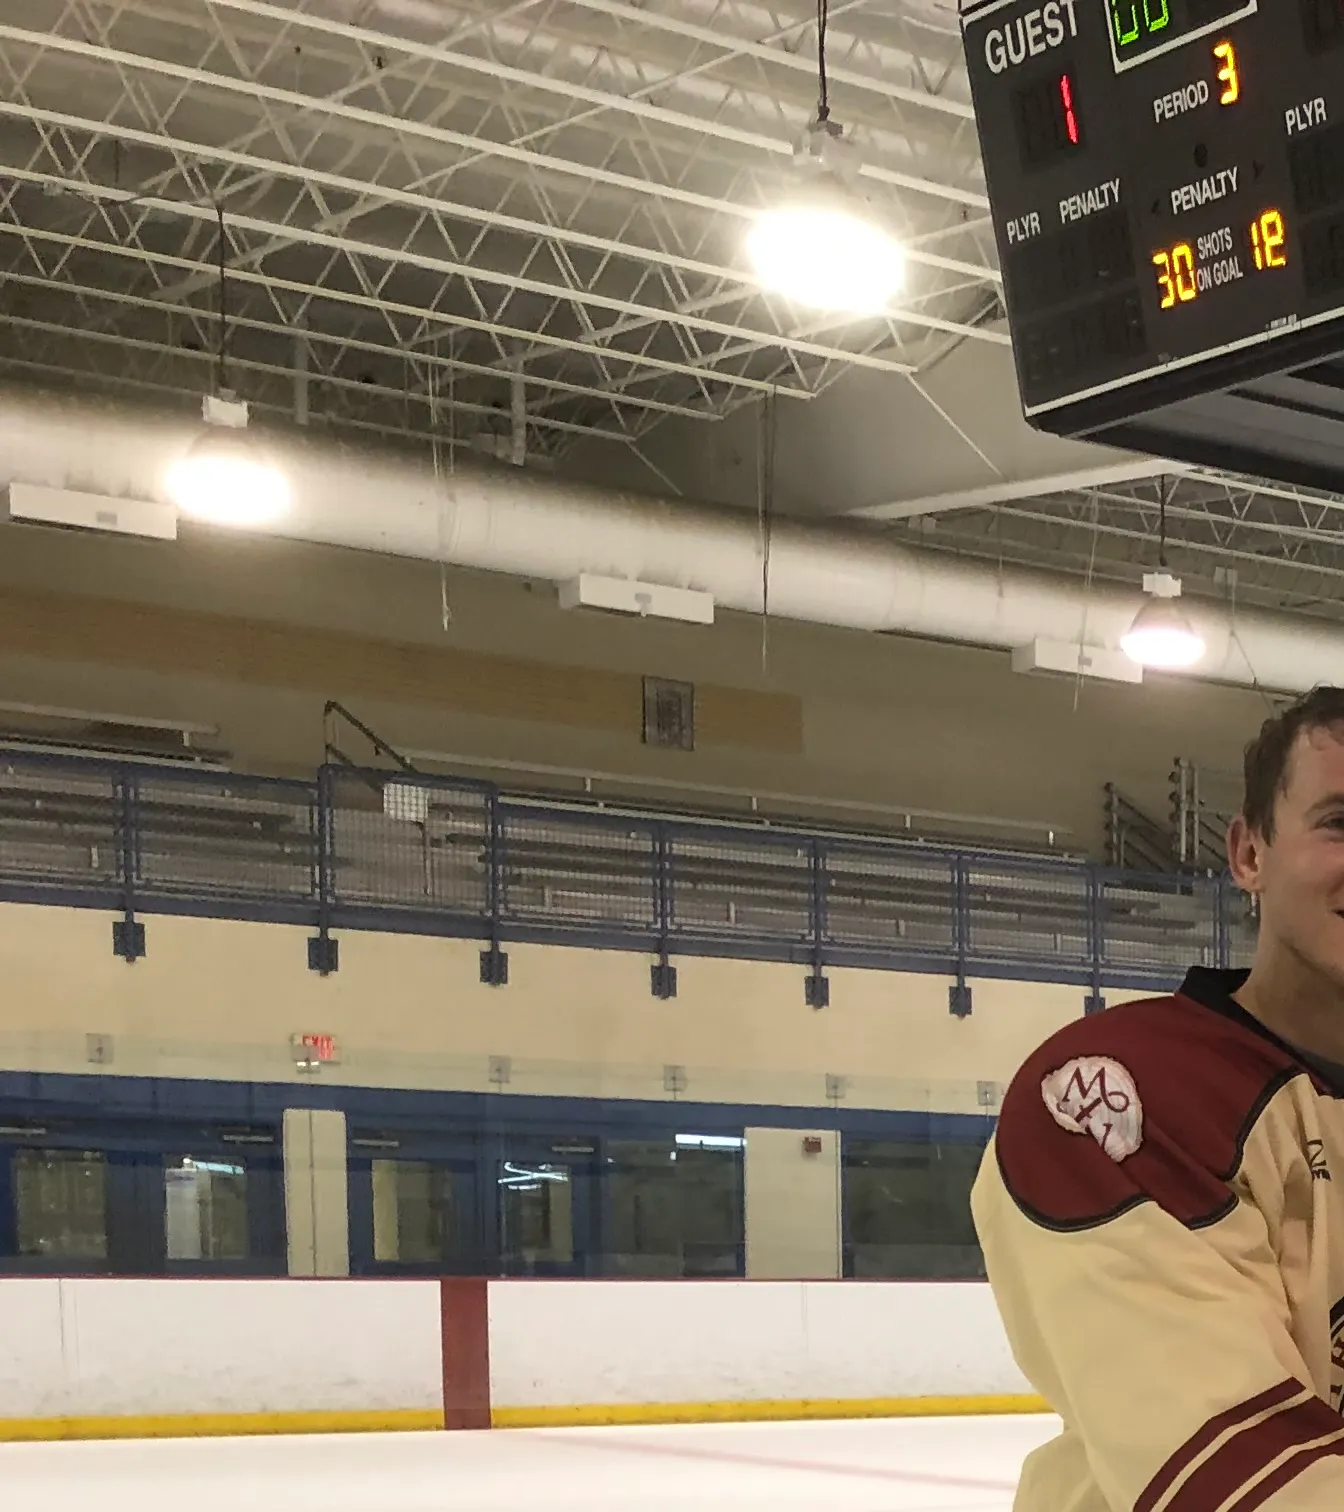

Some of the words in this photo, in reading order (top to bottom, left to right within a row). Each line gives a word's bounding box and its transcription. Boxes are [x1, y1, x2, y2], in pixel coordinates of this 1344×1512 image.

[985, 0, 1078, 74] GUEST
[1060, 75, 1079, 144] 1
[1153, 80, 1209, 123] PERIOD
[1213, 42, 1239, 105] 3
[1285, 97, 1327, 135] PLYR
[1007, 212, 1040, 244] PLYR
[1059, 178, 1120, 224] PENALTY
[1171, 166, 1239, 214] PENALTY
[1152, 243, 1196, 308] 30
[1196, 265, 1212, 292] ON
[1213, 255, 1244, 286] GOAL
[1197, 227, 1233, 260] SHOTS
